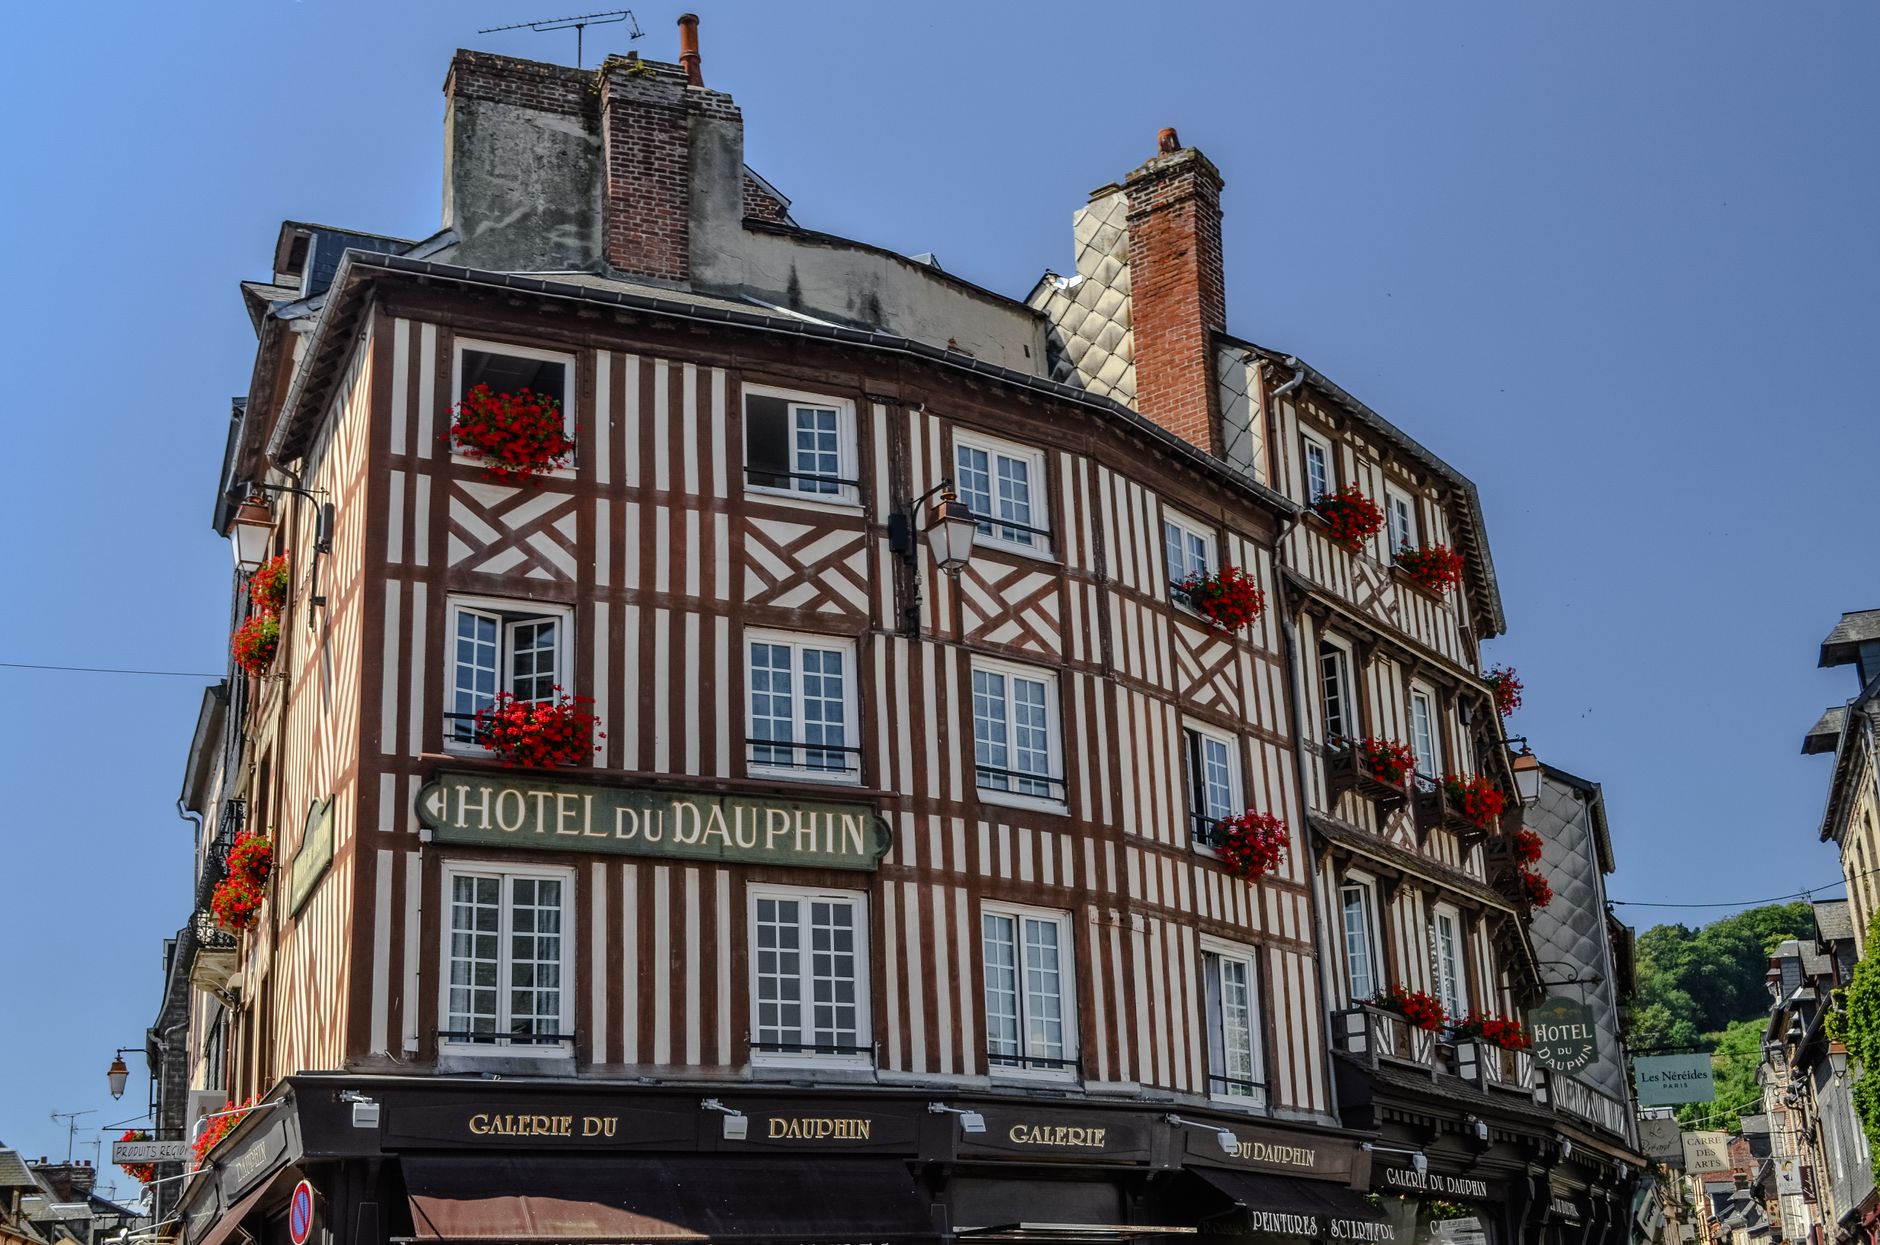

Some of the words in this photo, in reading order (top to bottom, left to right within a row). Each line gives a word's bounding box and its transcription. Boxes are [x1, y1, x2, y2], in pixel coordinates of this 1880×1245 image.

[453, 784, 608, 838] HOTEL
[615, 806, 664, 843] DU
[672, 800, 865, 856] DAUPHIN
[1533, 1023, 1593, 1043] HOTEL
[1537, 1044, 1593, 1071] DAUPHIN
[1557, 1046, 1572, 1055] DU
[1641, 1072, 1660, 1083] Les
[469, 1113, 573, 1137] GALERIE
[582, 1116, 618, 1137] DU
[768, 1117, 872, 1140] DAUPHIN
[1009, 1125, 1106, 1148] GALERIE
[1229, 1141, 1252, 1160] DU
[1253, 1145, 1316, 1168] DAUPHIN
[1694, 1160, 1721, 1169] ARTS
[1386, 1167, 1428, 1189] GALERIE
[1429, 1174, 1445, 1191] DU
[1446, 1176, 1487, 1197] DAUPHIN
[1252, 1211, 1318, 1236] PEINTURES
